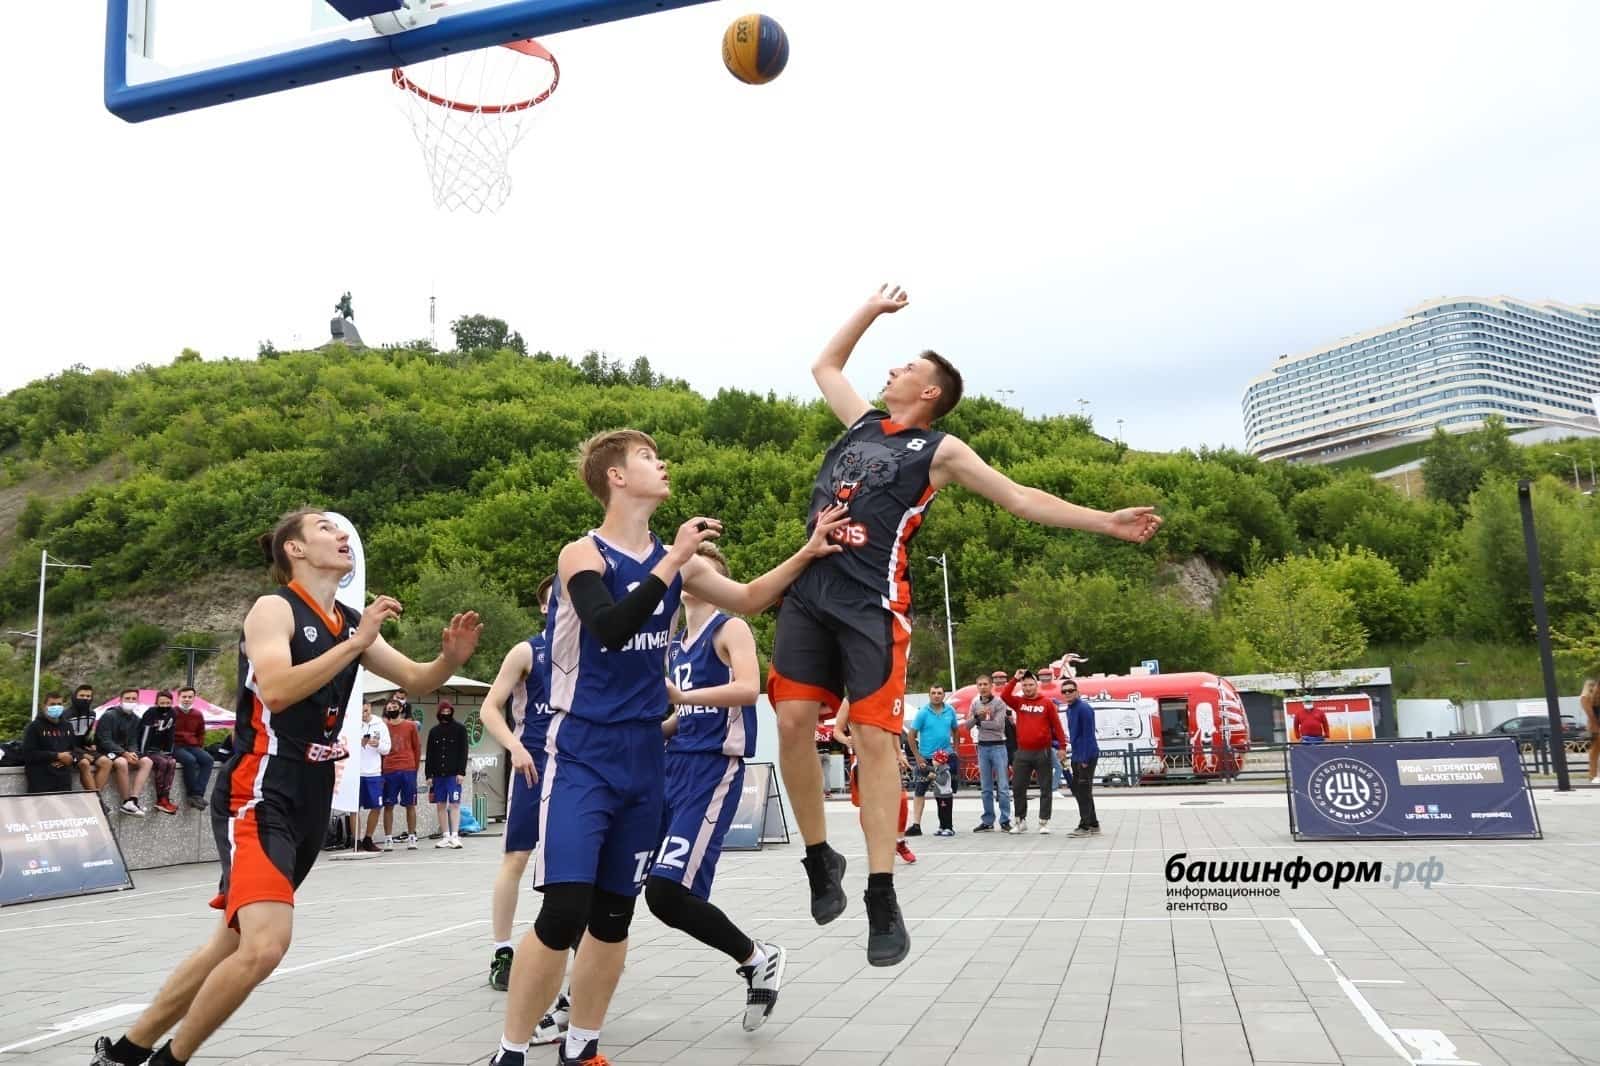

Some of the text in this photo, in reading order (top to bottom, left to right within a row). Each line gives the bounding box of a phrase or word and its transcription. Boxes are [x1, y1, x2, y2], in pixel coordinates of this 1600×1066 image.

[906, 438, 928, 451] 8
[831, 523, 866, 544] STS
[674, 662, 693, 690] 12
[893, 699, 902, 716] 8
[656, 836, 690, 869] 12
